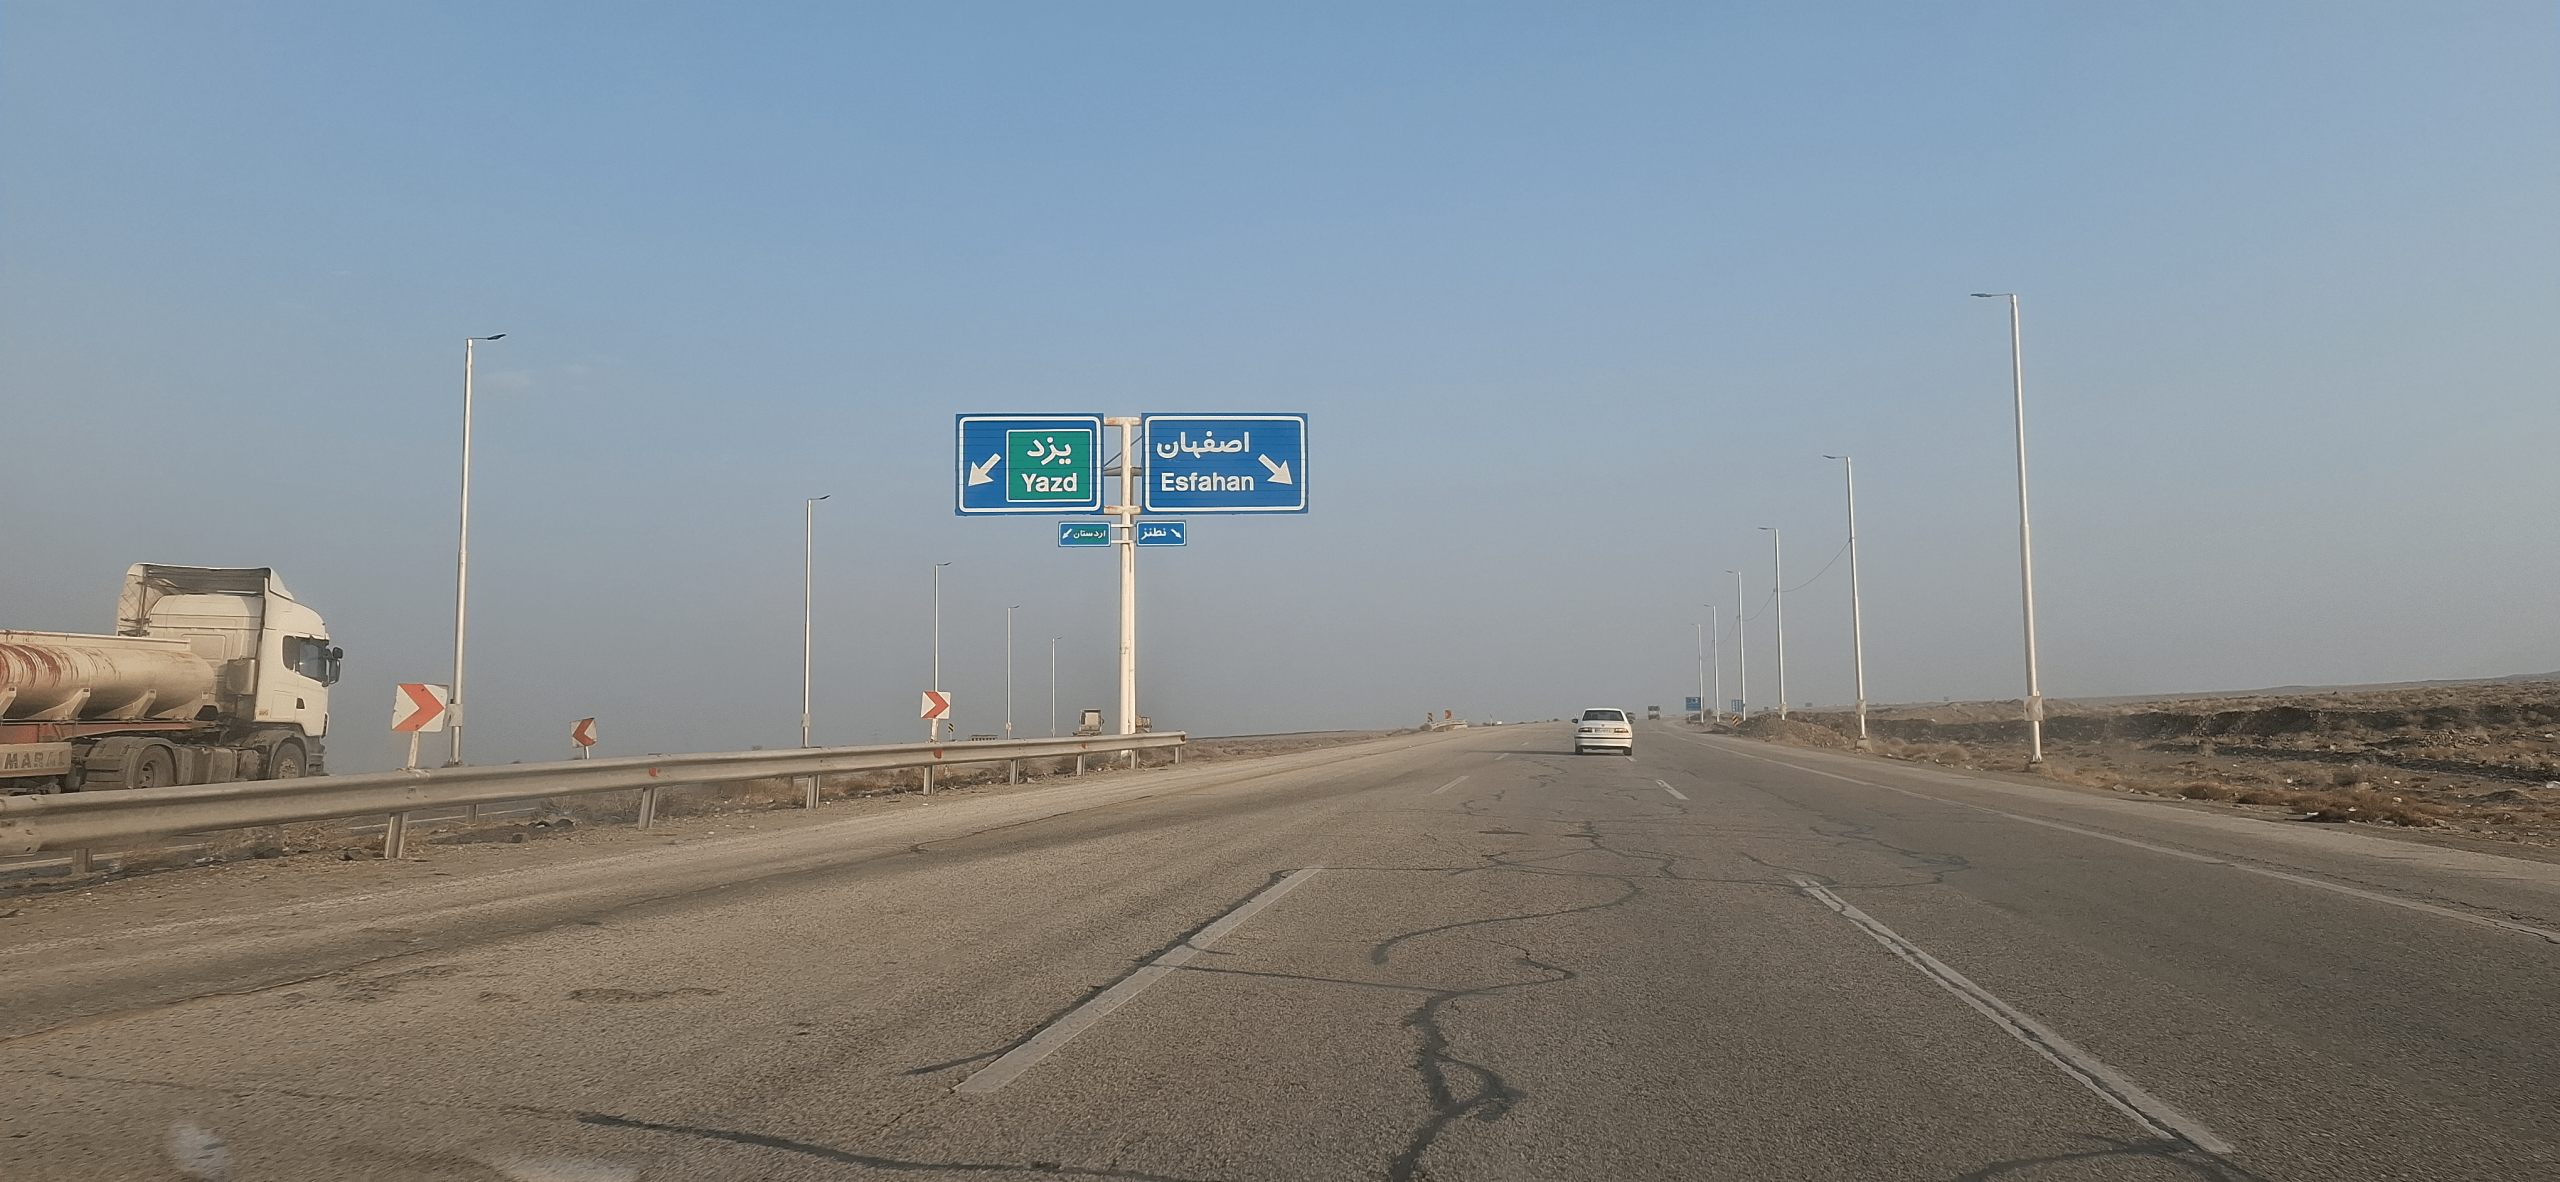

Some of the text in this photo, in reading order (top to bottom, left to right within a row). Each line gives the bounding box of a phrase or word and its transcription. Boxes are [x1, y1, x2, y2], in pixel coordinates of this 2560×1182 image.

[1026, 436, 1072, 466] یزد
[1157, 430, 1250, 459] اصفهان
[1021, 472, 1078, 492] Yazd
[1161, 472, 1255, 491] Esfahan
[1073, 529, 1106, 539] اردستان
[1140, 527, 1167, 540] نطنز
